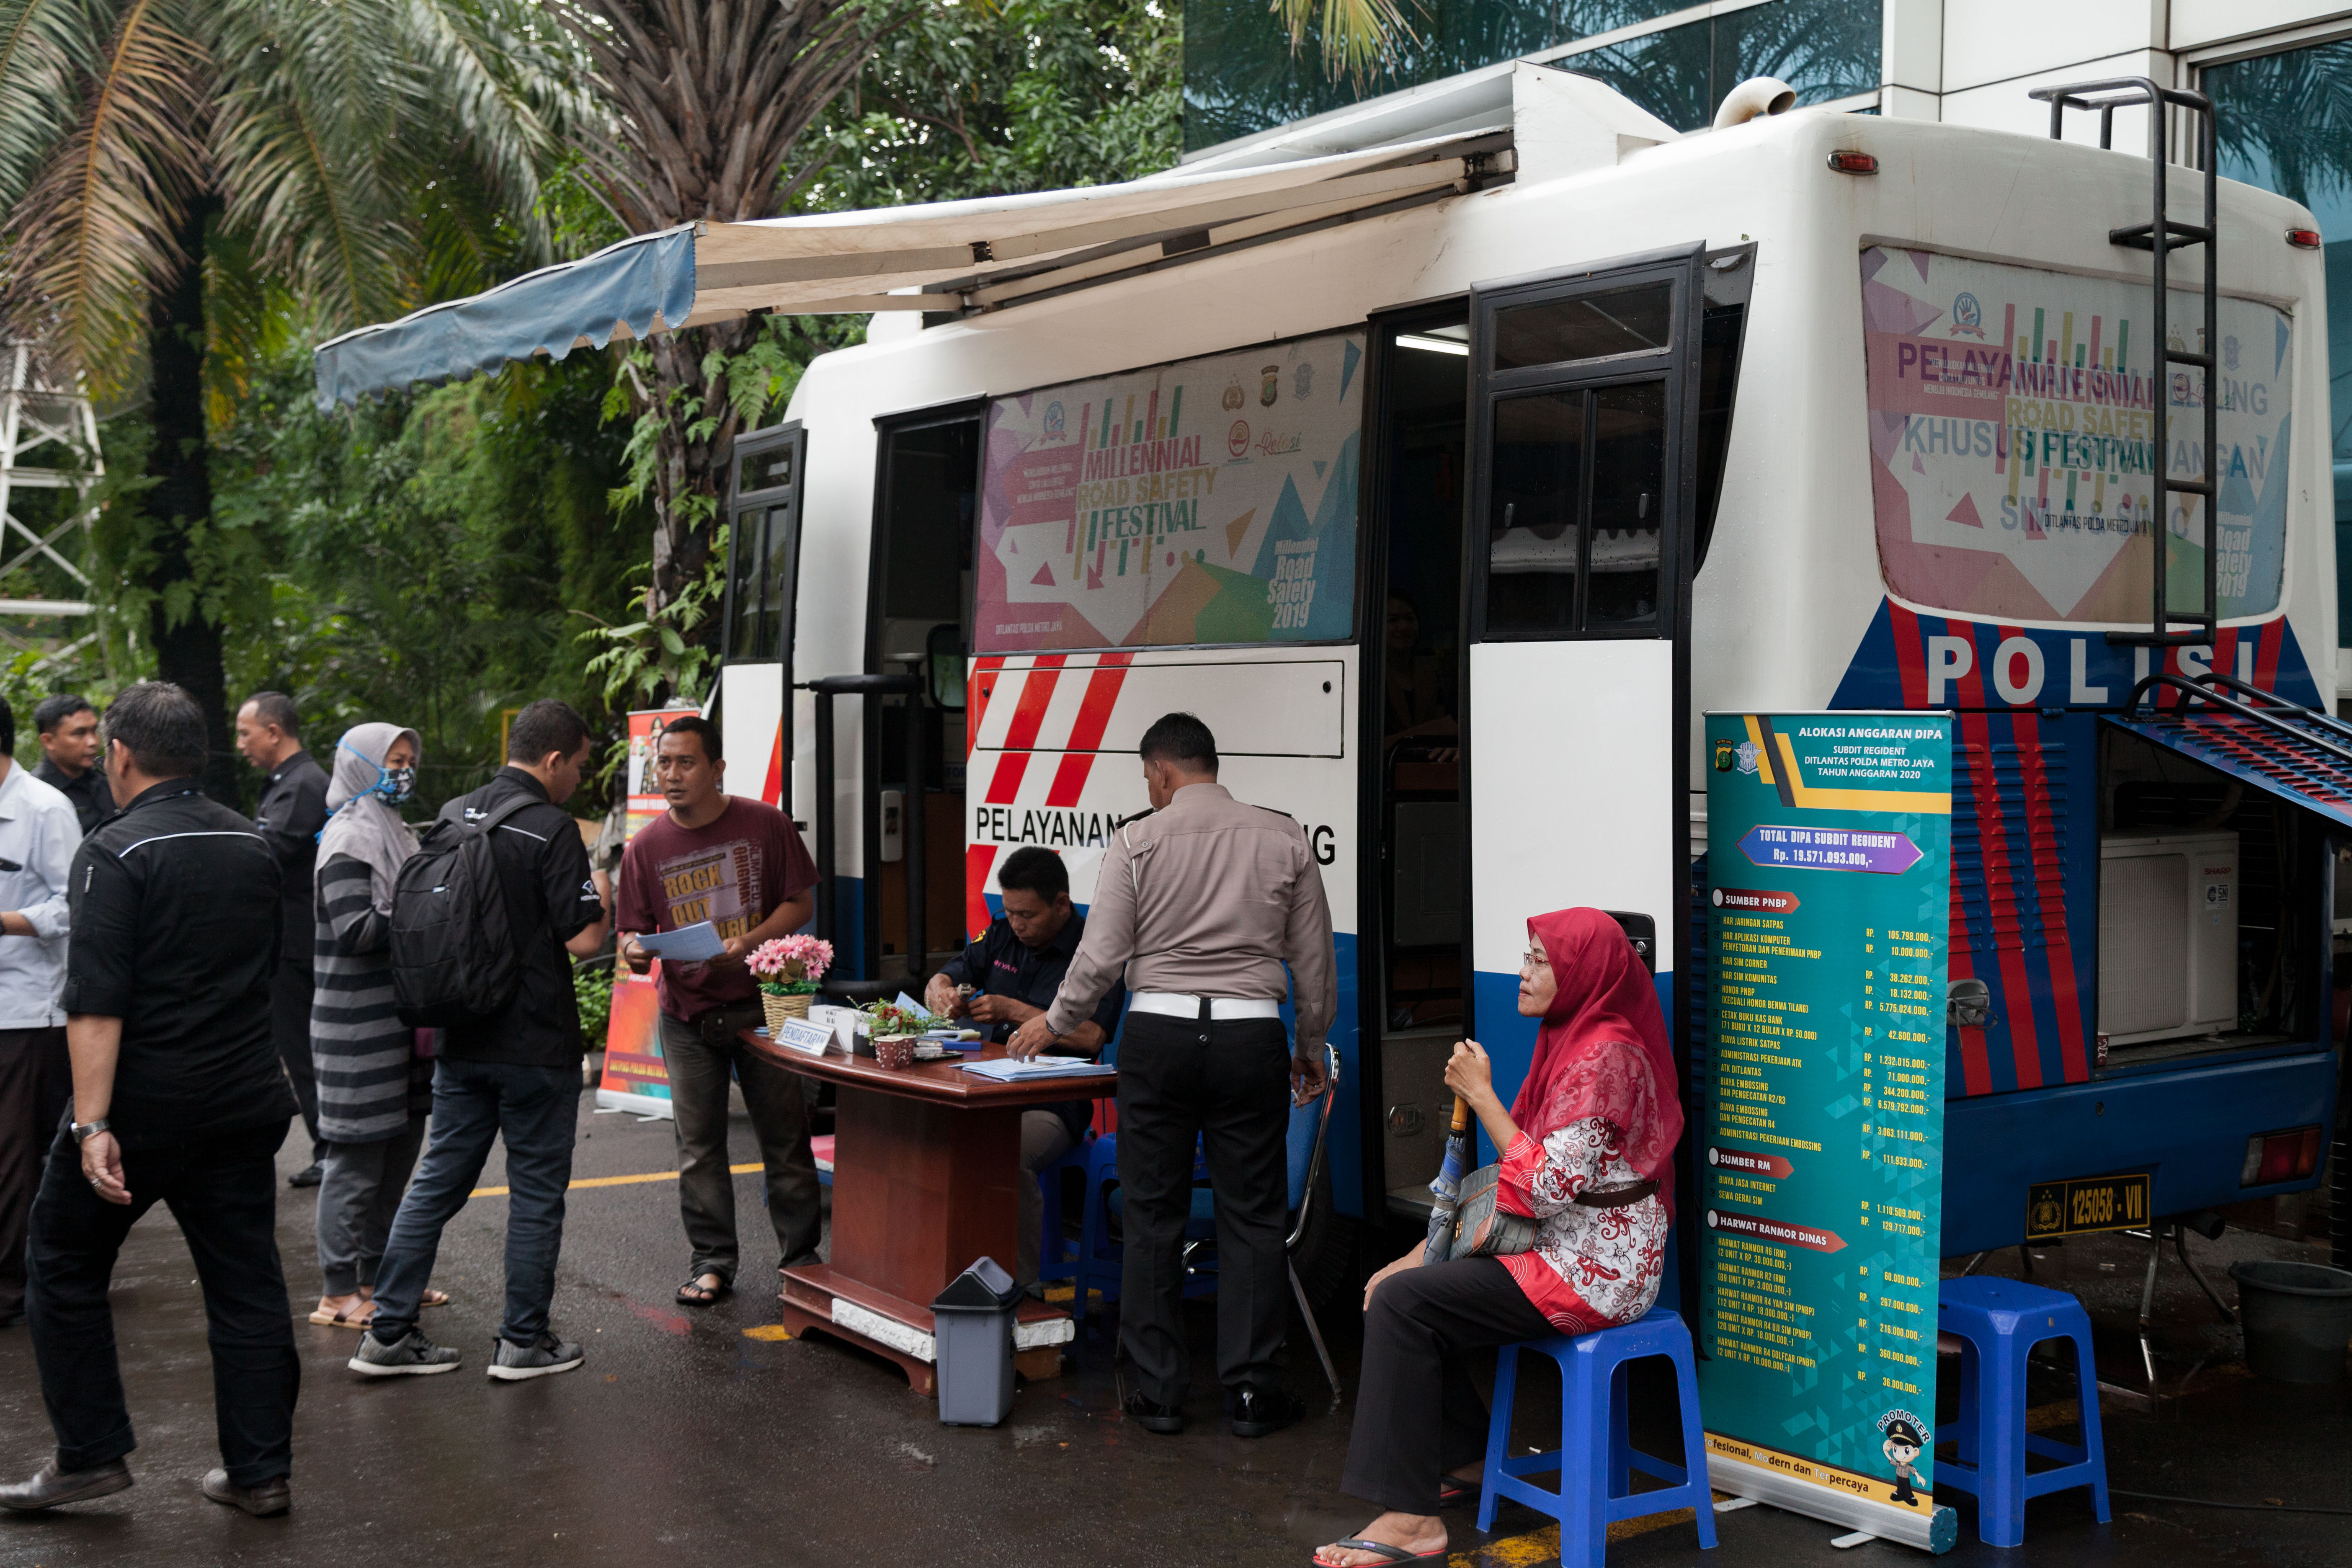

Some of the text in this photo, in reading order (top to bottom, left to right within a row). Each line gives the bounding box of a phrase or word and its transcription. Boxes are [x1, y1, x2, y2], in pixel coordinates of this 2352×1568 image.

[1939, 372, 1953, 383] CINTA
[1968, 375, 1985, 386] LINTAS
[1924, 384, 1944, 395] MENUJU
[1946, 386, 1972, 398] INDONESIA
[2006, 397, 2074, 431] ROAD
[1905, 416, 2034, 461] KHUSUS
[1085, 435, 1210, 482] MILLENNIAL
[1077, 479, 1130, 511] ROAD
[1136, 466, 1218, 503] SAFETY
[1102, 498, 1207, 539] FESTIVAL
[2000, 494, 2050, 532] SIM
[2045, 514, 2147, 534] DITLANTAS POLDA METRO JAYA
[1275, 536, 1319, 555] Millennial
[2216, 526, 2251, 551] Road
[1275, 552, 1315, 580] Road
[2216, 547, 2252, 575] afety
[1267, 575, 1316, 604] Safety
[2216, 572, 2247, 598] 2019
[1272, 602, 1310, 628] 2019
[1927, 635, 2253, 705] POLISI
[1798, 727, 1943, 740] ALOKASI ANGGARAN DIPA
[1833, 745, 1906, 756] SUBDIT REGIDENT
[1805, 756, 1934, 768] DITLANTAS POLDA METRO JAYA
[1818, 768, 1921, 779] TAHUN ANGGARAN 2020
[977, 807, 1122, 848] PELAYANAN
[1760, 829, 1897, 848] TOTAL DIPA SUBDIT REGIDENT
[1774, 848, 1873, 867] Rp. 19.571.093.000,-
[663, 863, 724, 899] ROCK
[733, 846, 750, 906] ORIGINAL
[1725, 895, 1787, 908] SUMBER PNBP
[2218, 888, 2228, 899] SNI
[671, 897, 711, 926] OUT
[1723, 916, 1784, 929] HAR JARINGAN SATPAS
[1723, 931, 1790, 945] HAR APLIKASI KOMPUTER
[1866, 928, 1934, 943] RP. 105.798.000,-
[1723, 941, 1821, 959] PENYETORAN DAN PENERIMAAN PNBP
[1866, 944, 1934, 959] RP. 10.000.000,-
[1722, 957, 1767, 969] HAR SIM CORNER
[1722, 971, 1777, 984] HAR SIM KOMUNITAS
[1865, 970, 1933, 986] RP. 38.262.000,-
[1722, 985, 1755, 996] HONOR PNBP
[1865, 985, 1933, 1001] RP. 18.132.000,-
[1722, 995, 1808, 1013] (KECUALI HONOR BENMA TILANG)
[1865, 1000, 1932, 1017] RP. 5.775.024.000,-
[1721, 1010, 1783, 1025] CETAK BUKU KAS BANK
[784, 1026, 826, 1047] PENDAFTARAN
[1864, 1026, 1932, 1044] RP. 42.600.000,-
[1720, 1049, 1802, 1068] ADMINISTRASI PEKERJAAN ATK
[1720, 1077, 1768, 1091] BIAYA EMBOSSING
[1720, 1087, 1786, 1105] DAN PENGECATAN R2/R3
[1720, 1154, 1770, 1171] SUMBER RM
[1719, 1175, 1776, 1193] BIAYA JASA INTERNET
[1718, 1190, 1763, 1205] SEWA GERAI SIM
[2073, 1187, 2114, 1225] 125058
[2126, 1184, 2141, 1220] VII
[1720, 1217, 1827, 1246] HARWAT RANMOR DINAS
[1718, 1237, 1786, 1259] HARWAT RANMOR R6 (RM)
[1717, 1336, 1816, 1368] HARWAT RANMOR R4 GOLFCAR (PNBP)
[1877, 1409, 1930, 1443] PROMOTER
[1704, 1438, 1868, 1493] rofesional, Modern dan Terpercaya
